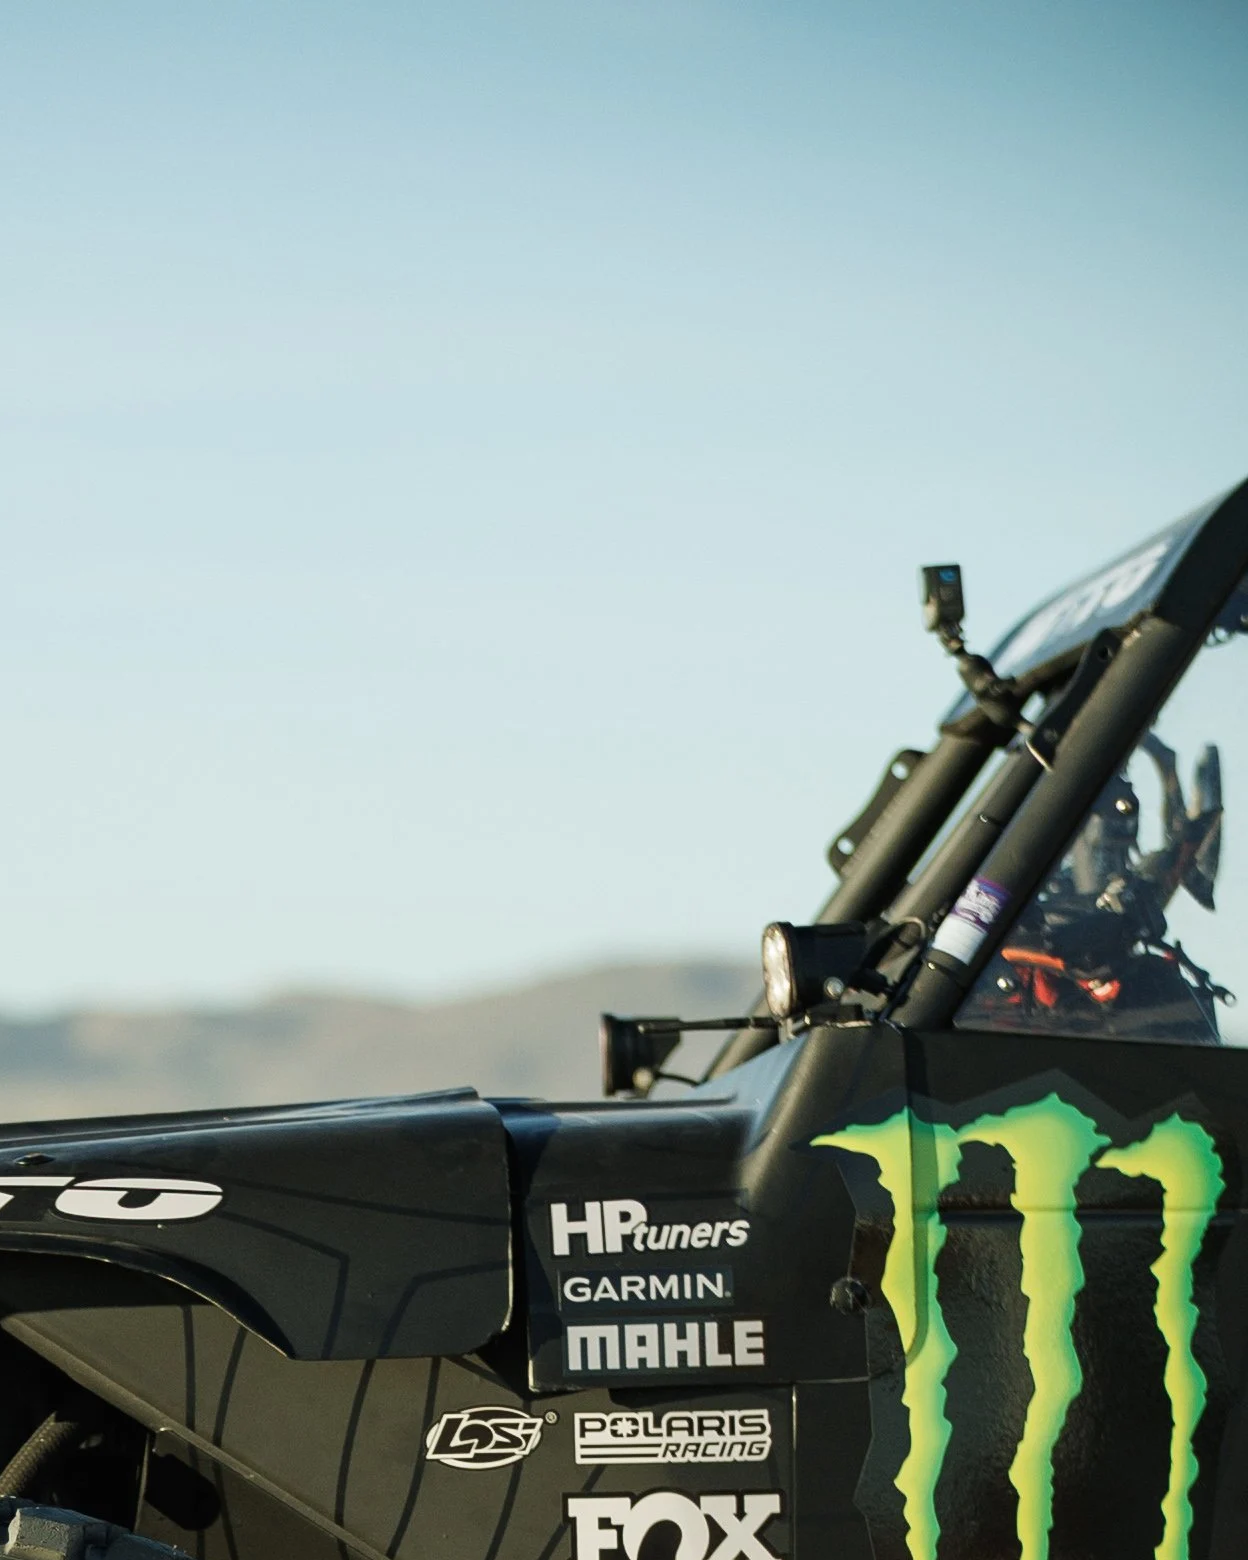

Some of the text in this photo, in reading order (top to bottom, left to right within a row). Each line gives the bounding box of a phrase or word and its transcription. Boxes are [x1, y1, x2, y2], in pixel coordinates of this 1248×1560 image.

[563, 1272, 726, 1303] GARMIN
[567, 1320, 765, 1371] MAHLE
[578, 1413, 768, 1439] POLARIS
[662, 1440, 767, 1459] RACING
